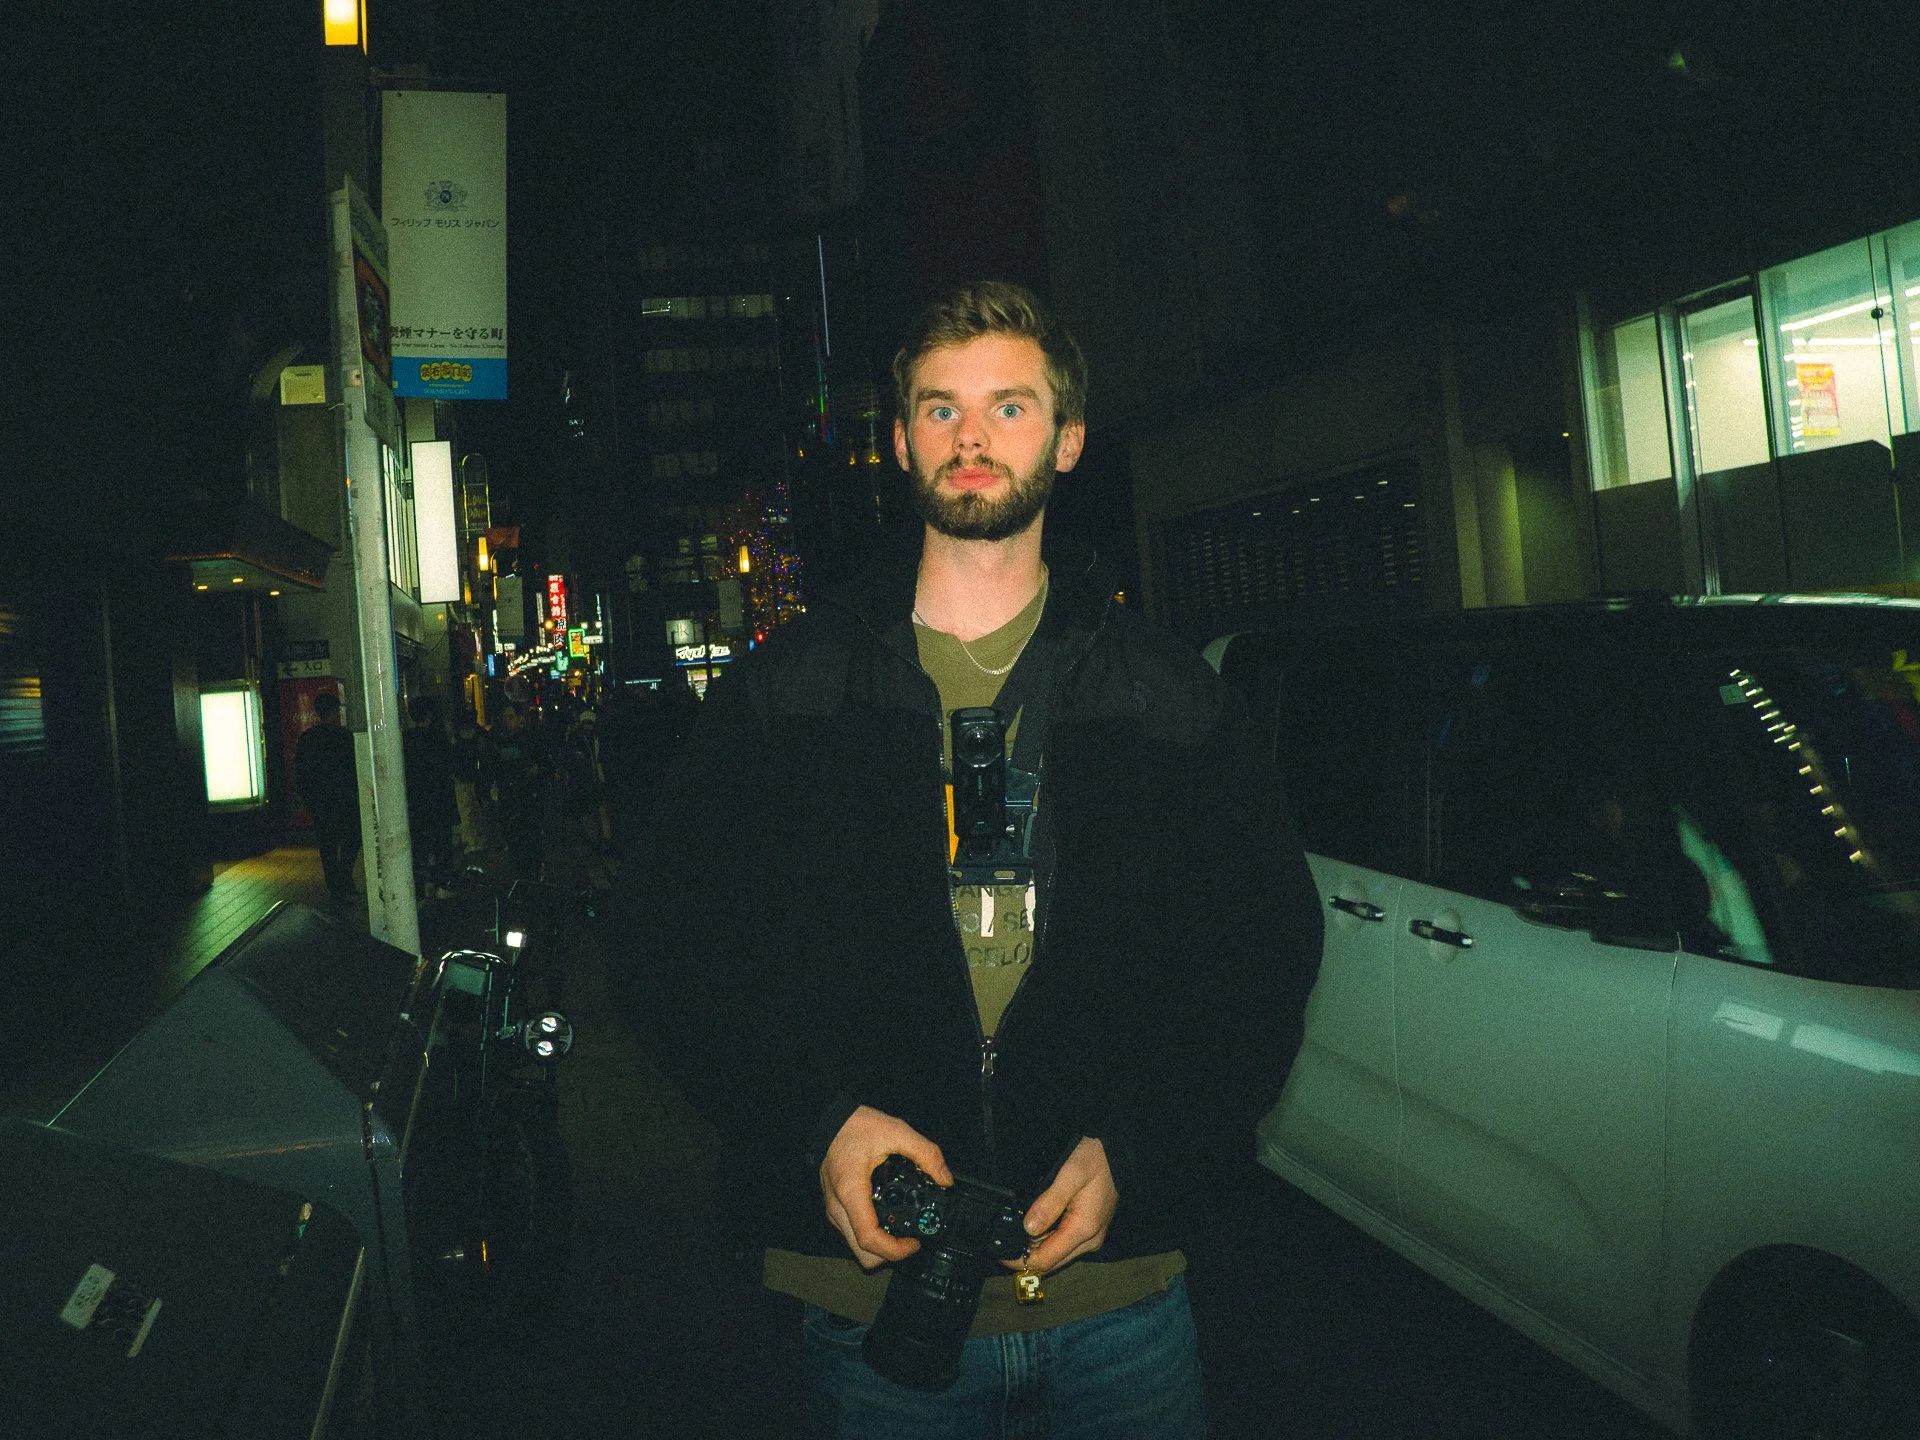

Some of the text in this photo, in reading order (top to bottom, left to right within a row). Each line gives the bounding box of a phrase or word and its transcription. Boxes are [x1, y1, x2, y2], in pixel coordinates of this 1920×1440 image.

[436, 219, 461, 229] モリス
[465, 219, 500, 229] ジャパン
[304, 661, 323, 671] 入口
